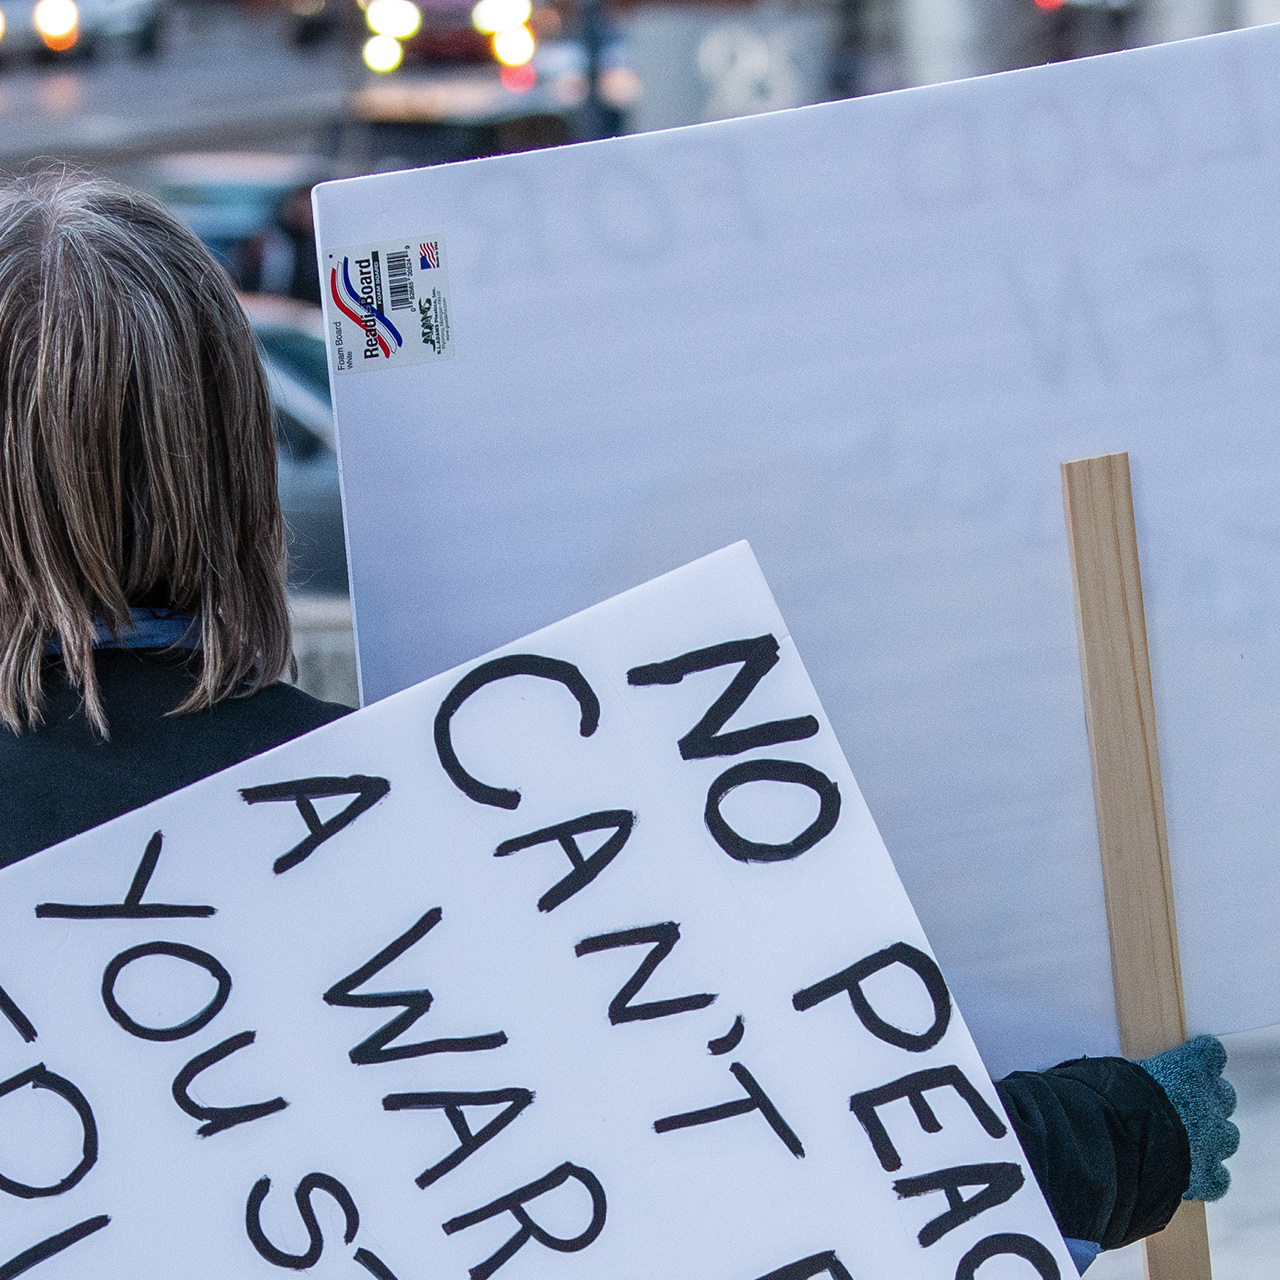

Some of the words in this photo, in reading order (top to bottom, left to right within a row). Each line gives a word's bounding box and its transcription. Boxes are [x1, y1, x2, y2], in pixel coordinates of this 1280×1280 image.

[355, 258, 380, 360] Readi-Board
[373, 261, 381, 285] BOARD
[333, 321, 344, 347] Board
[337, 346, 346, 371] Foam
[627, 634, 841, 863] NO
[238, 775, 391, 875] A
[434, 653, 806, 1159] CAN'T
[35, 830, 289, 1139] YOU
